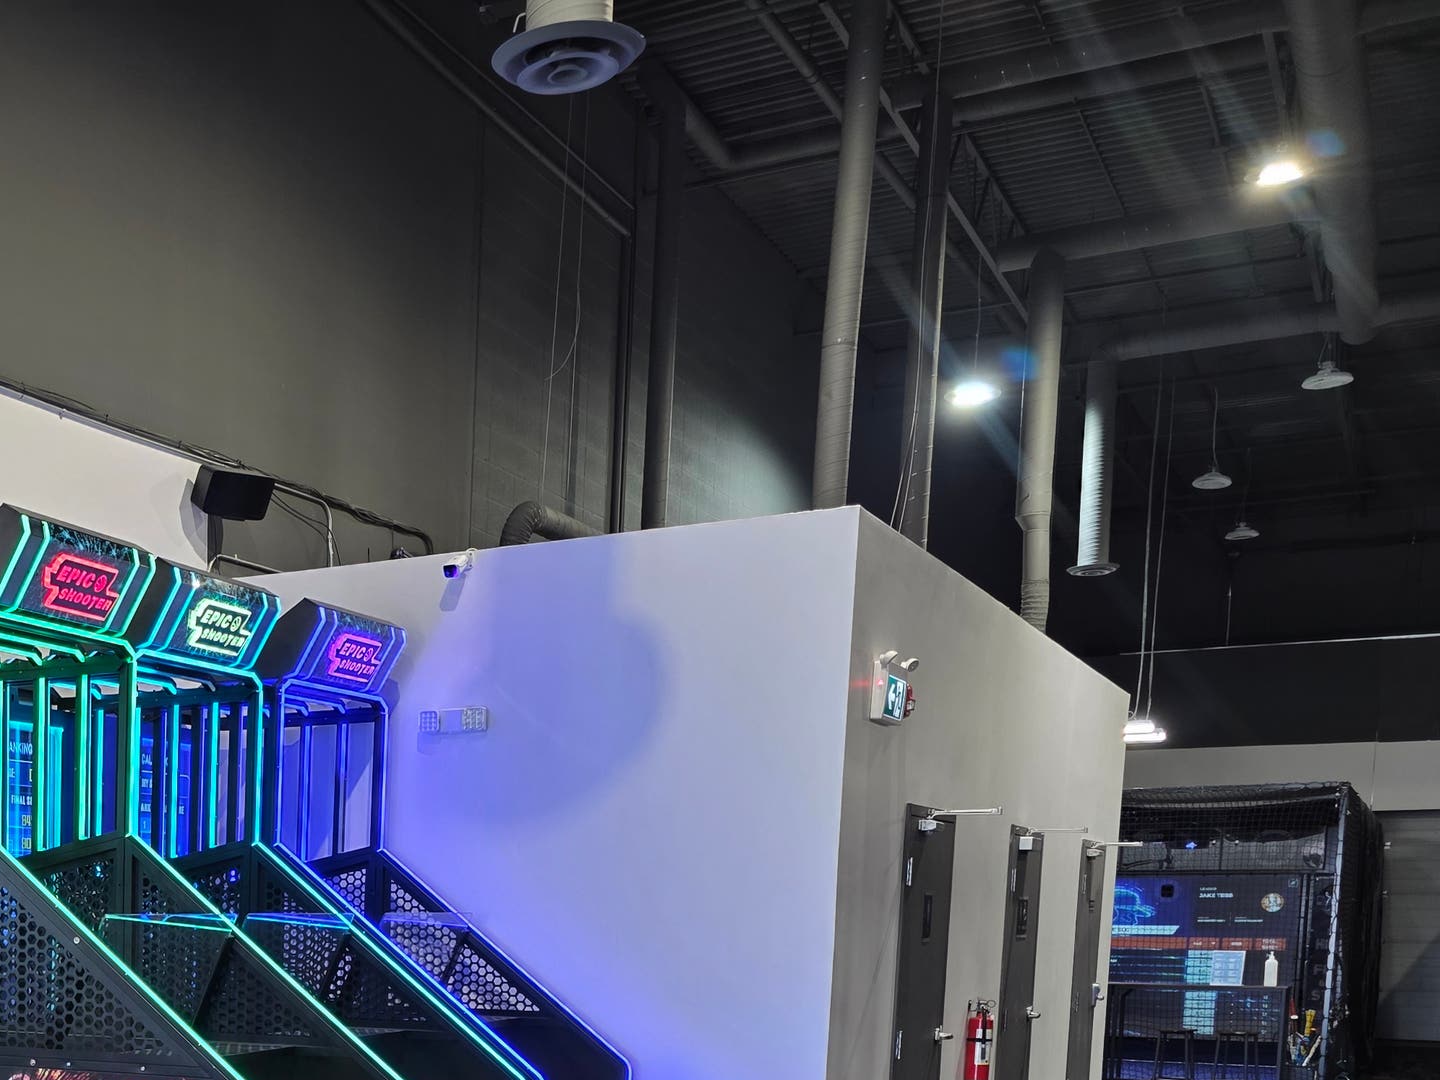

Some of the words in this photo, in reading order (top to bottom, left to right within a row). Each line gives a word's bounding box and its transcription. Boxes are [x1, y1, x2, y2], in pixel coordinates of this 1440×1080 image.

[56, 565, 96, 588] EPIC
[58, 588, 113, 611] SHOOTER
[200, 609, 233, 629] EPIC
[201, 628, 245, 647] SHOOTER
[339, 642, 367, 659] EPIC
[339, 659, 375, 675] SHOOTER
